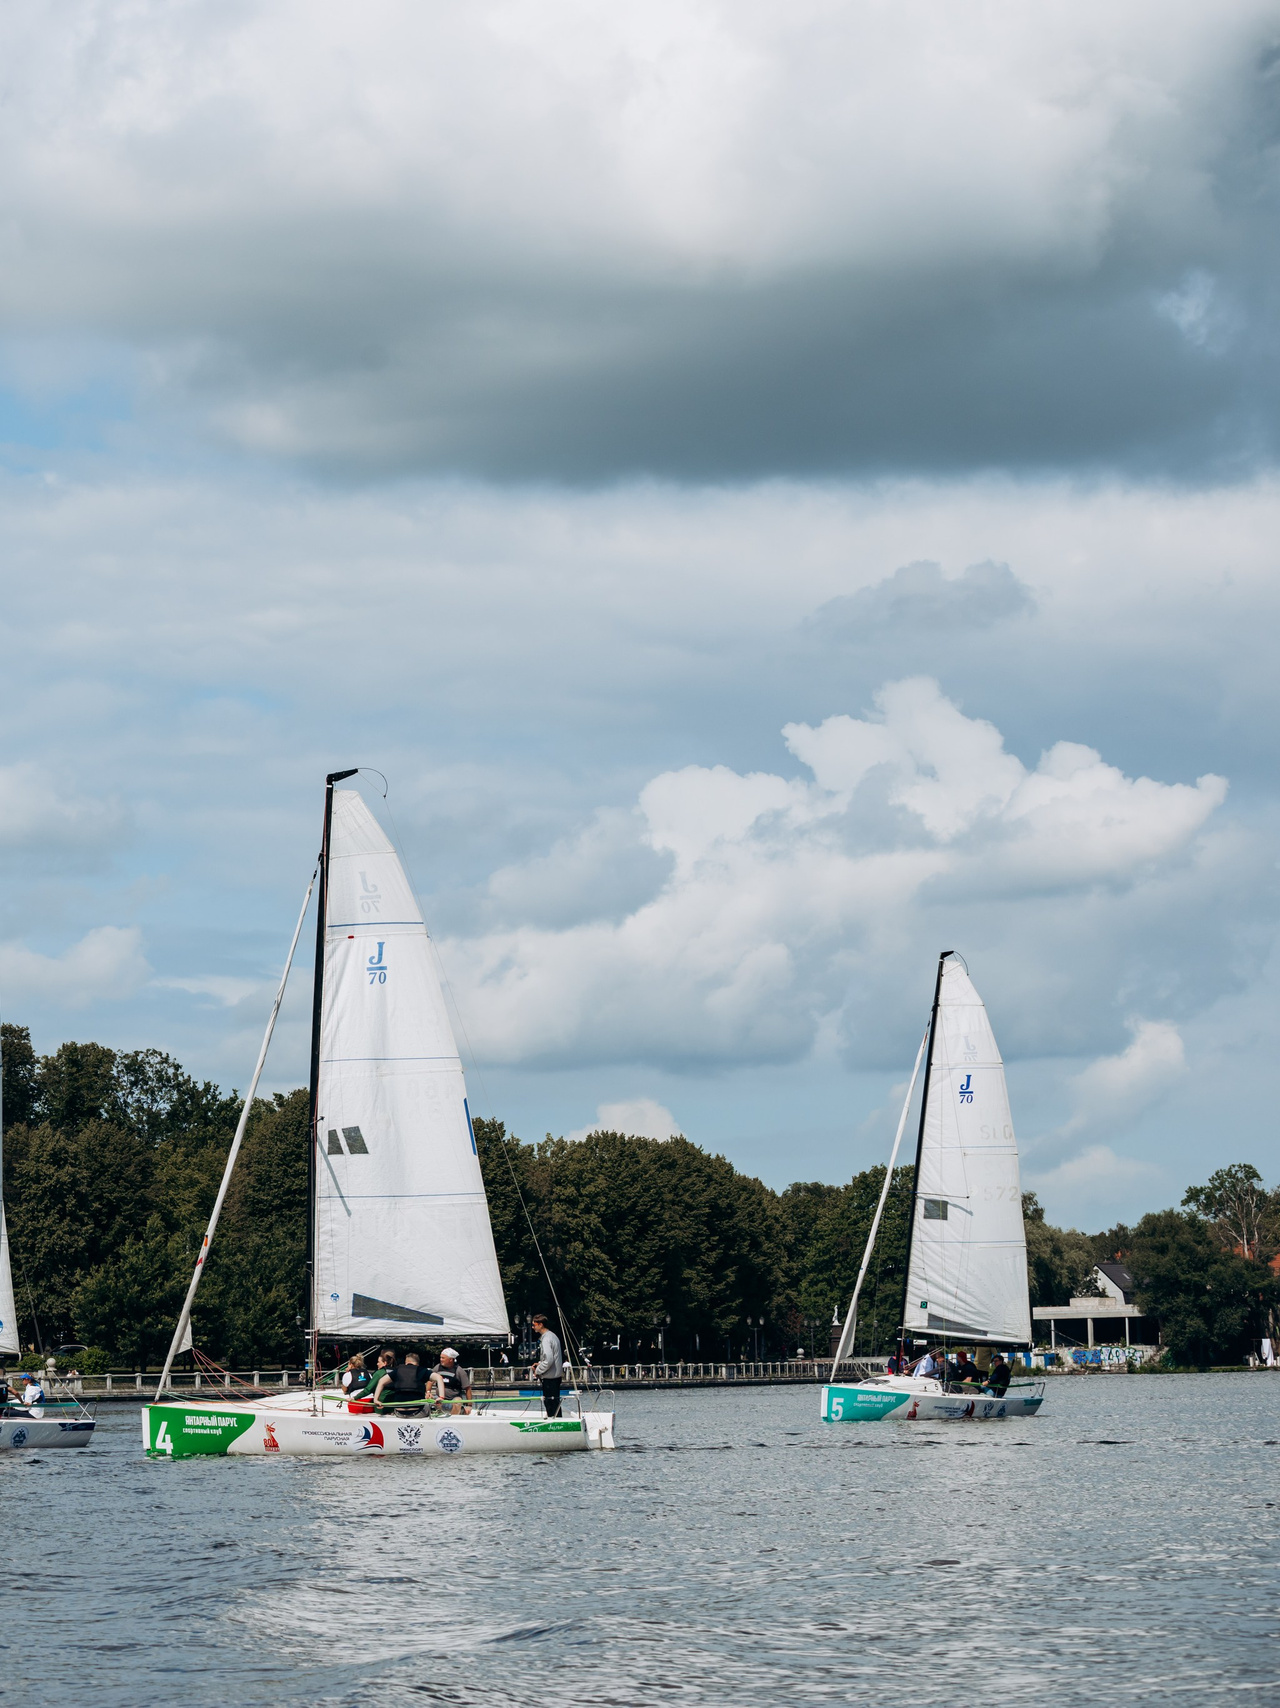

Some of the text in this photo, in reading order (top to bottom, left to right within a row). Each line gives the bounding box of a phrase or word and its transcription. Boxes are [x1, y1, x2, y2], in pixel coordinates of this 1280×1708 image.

[368, 942, 385, 965] J
[368, 971, 387, 985] 70
[960, 1074, 972, 1091] J
[959, 1094, 973, 1104] 70
[831, 1397, 844, 1420] 5
[185, 1415, 238, 1427] ЯНТАРНЫЙ ПАРУС
[156, 1421, 173, 1454] 4
